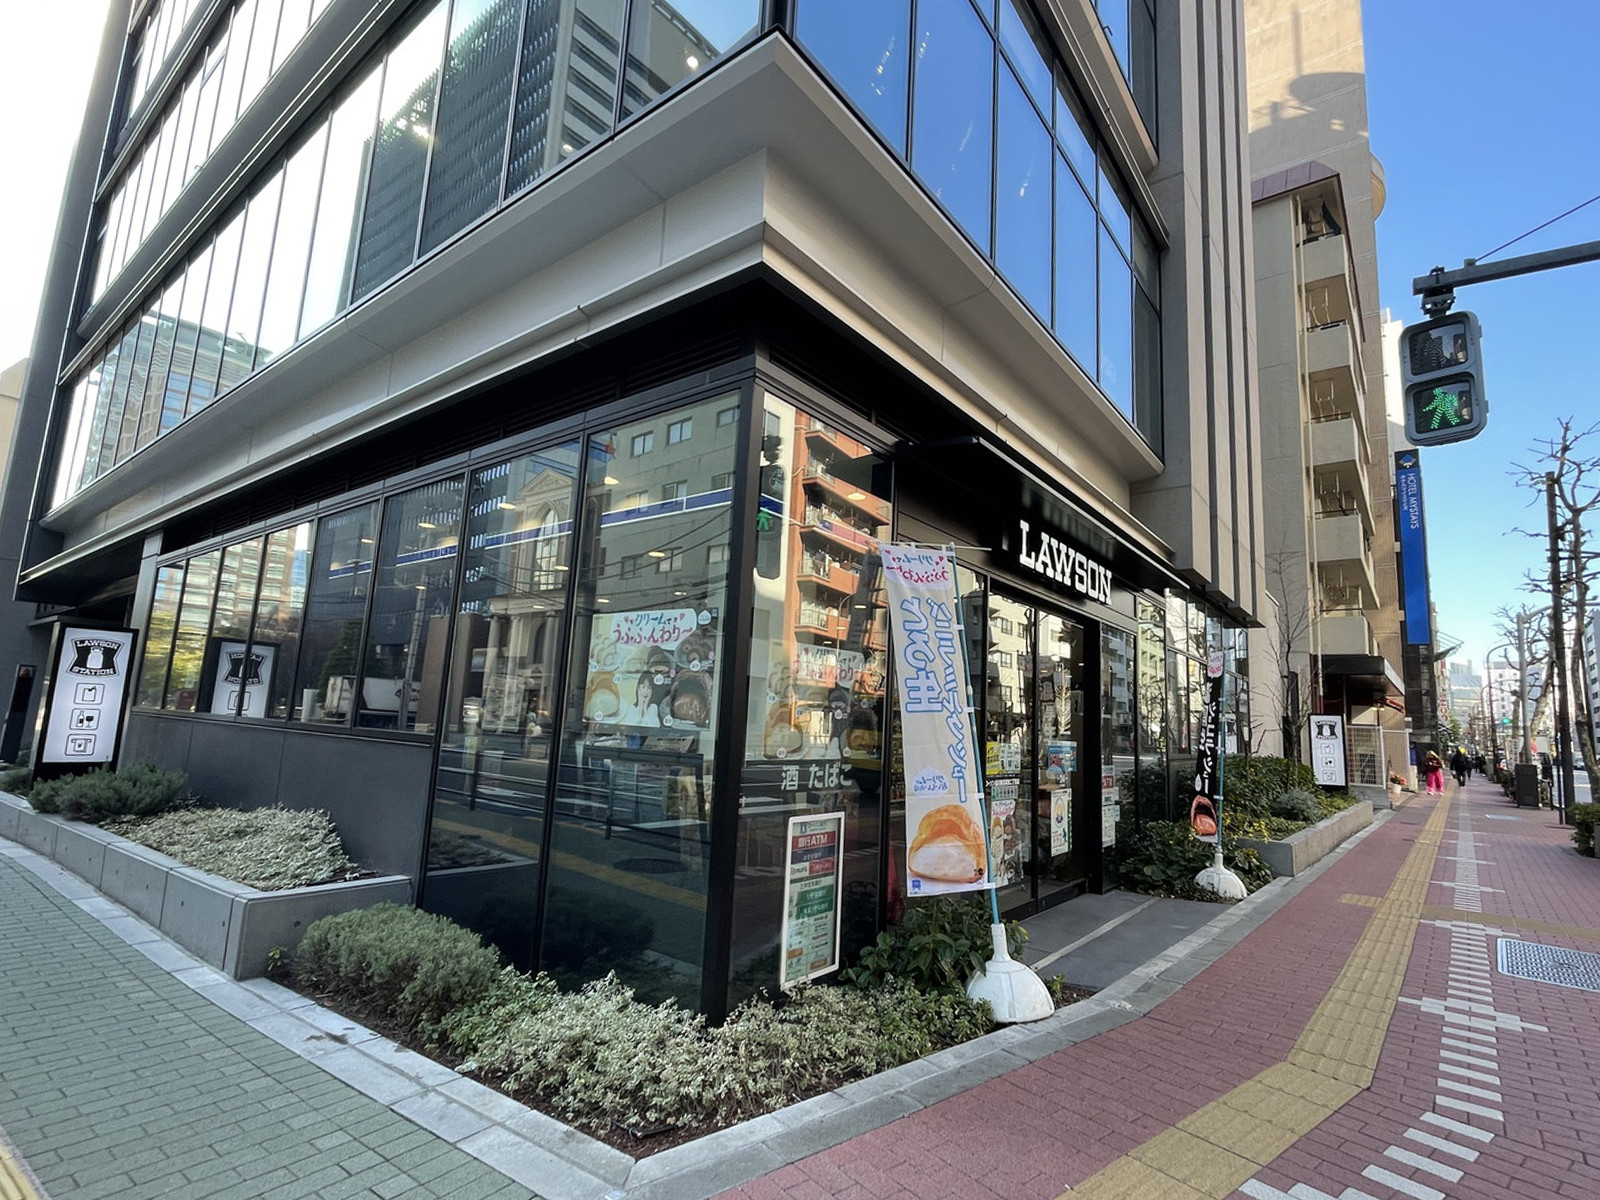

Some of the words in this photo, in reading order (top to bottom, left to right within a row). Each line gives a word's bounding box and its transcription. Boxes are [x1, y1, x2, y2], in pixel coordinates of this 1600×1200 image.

[1407, 473, 1417, 496] HOTEL
[1019, 519, 1113, 606] LAWSON
[76, 639, 119, 650] LAWSON
[72, 666, 114, 675] STATION
[781, 764, 800, 791] 酒
[808, 762, 853, 789] たばこ
